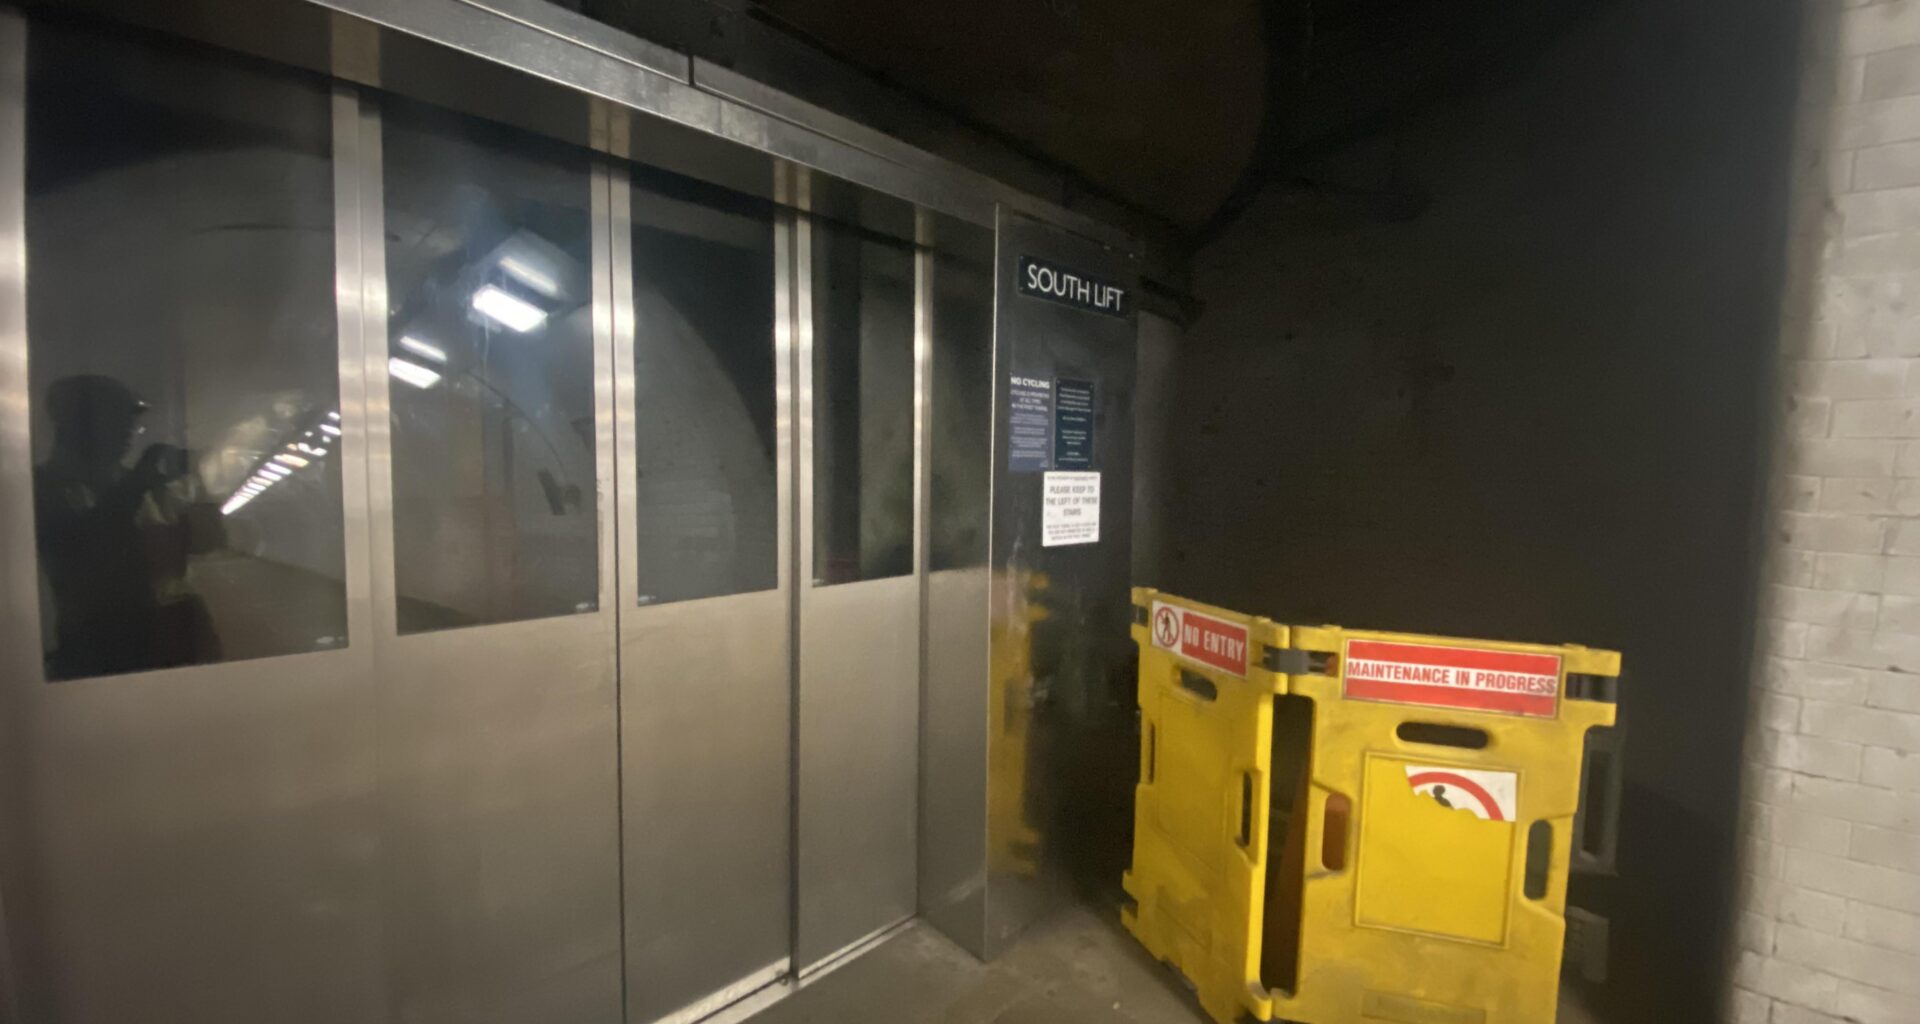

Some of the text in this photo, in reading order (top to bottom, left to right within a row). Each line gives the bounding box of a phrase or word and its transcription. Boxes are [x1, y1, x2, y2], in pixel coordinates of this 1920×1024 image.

[1028, 264, 1124, 311] SOUTH LIFT
[1010, 377, 1050, 389] NO CYCLING
[1049, 486, 1071, 494] PLEASE
[1183, 623, 1245, 662] NO ENTRY
[1348, 661, 1556, 694] MAINTENANCE IN PROGRESS
